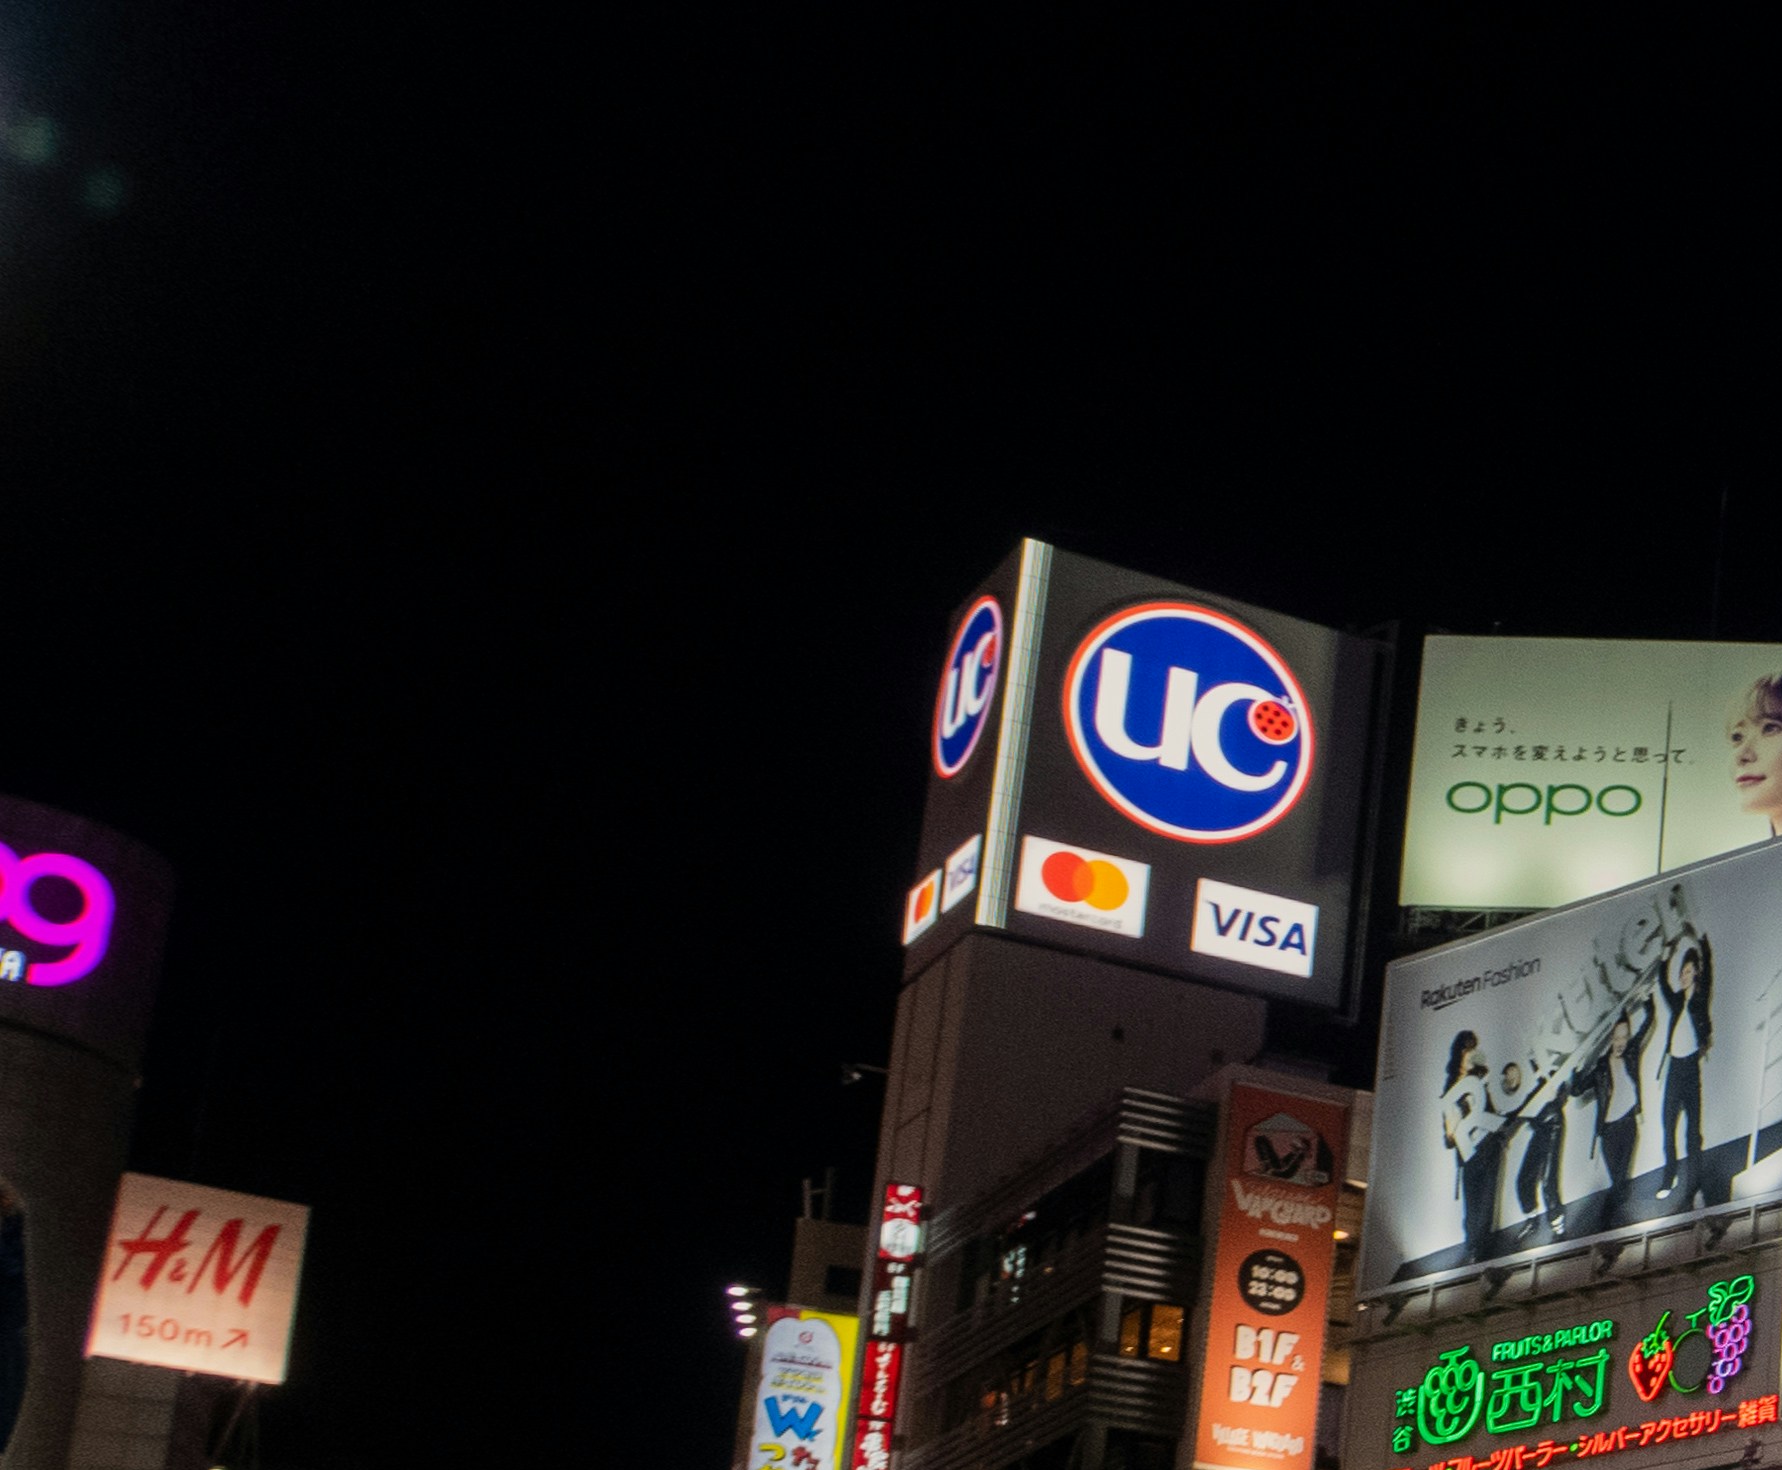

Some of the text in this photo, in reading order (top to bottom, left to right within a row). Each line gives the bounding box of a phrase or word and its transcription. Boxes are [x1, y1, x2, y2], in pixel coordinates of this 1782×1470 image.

[942, 633, 999, 740] UC
[1095, 648, 1290, 793] UC
[1446, 781, 1643, 826] oppo
[0, 843, 116, 987] 9
[1207, 899, 1308, 957] VISA
[1420, 955, 1542, 1011] Rakuten Fashion
[113, 1204, 282, 1308] H&M
[119, 1312, 212, 1349] 150m
[1234, 1323, 1300, 1366] B1F
[1230, 1366, 1299, 1408] B2F
[1486, 1348, 1610, 1434] 西村
